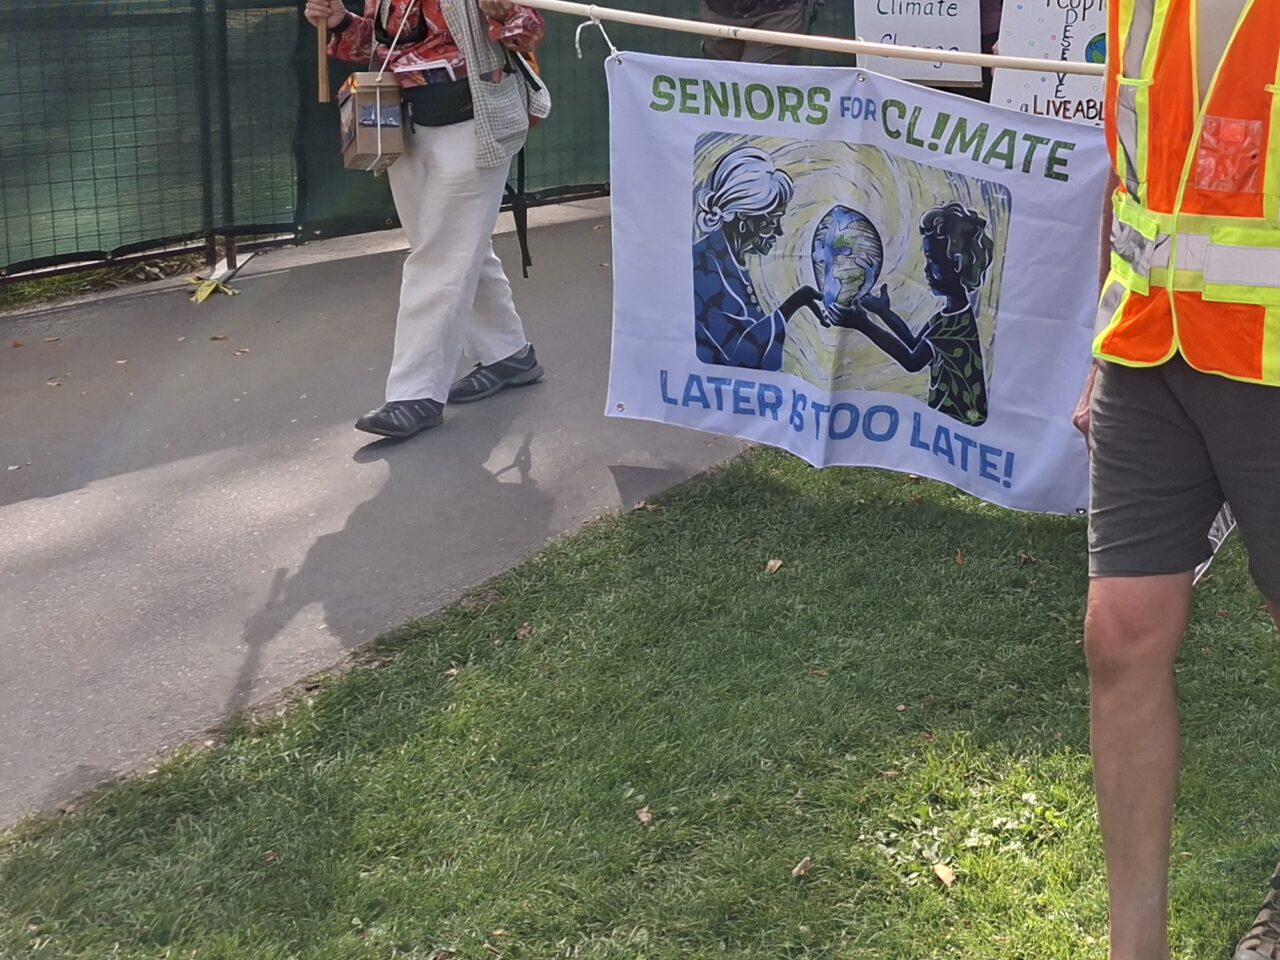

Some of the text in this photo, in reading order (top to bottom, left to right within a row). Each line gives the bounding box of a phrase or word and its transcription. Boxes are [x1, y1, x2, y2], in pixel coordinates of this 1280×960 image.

[1054, 8, 1078, 99] DESEVE
[649, 74, 1076, 183] SENIORS FOR CL!MATE
[1033, 94, 1106, 121] LIVEABL
[659, 369, 784, 422] LATER
[809, 402, 901, 442] TOO
[909, 411, 1016, 489] LATE!
